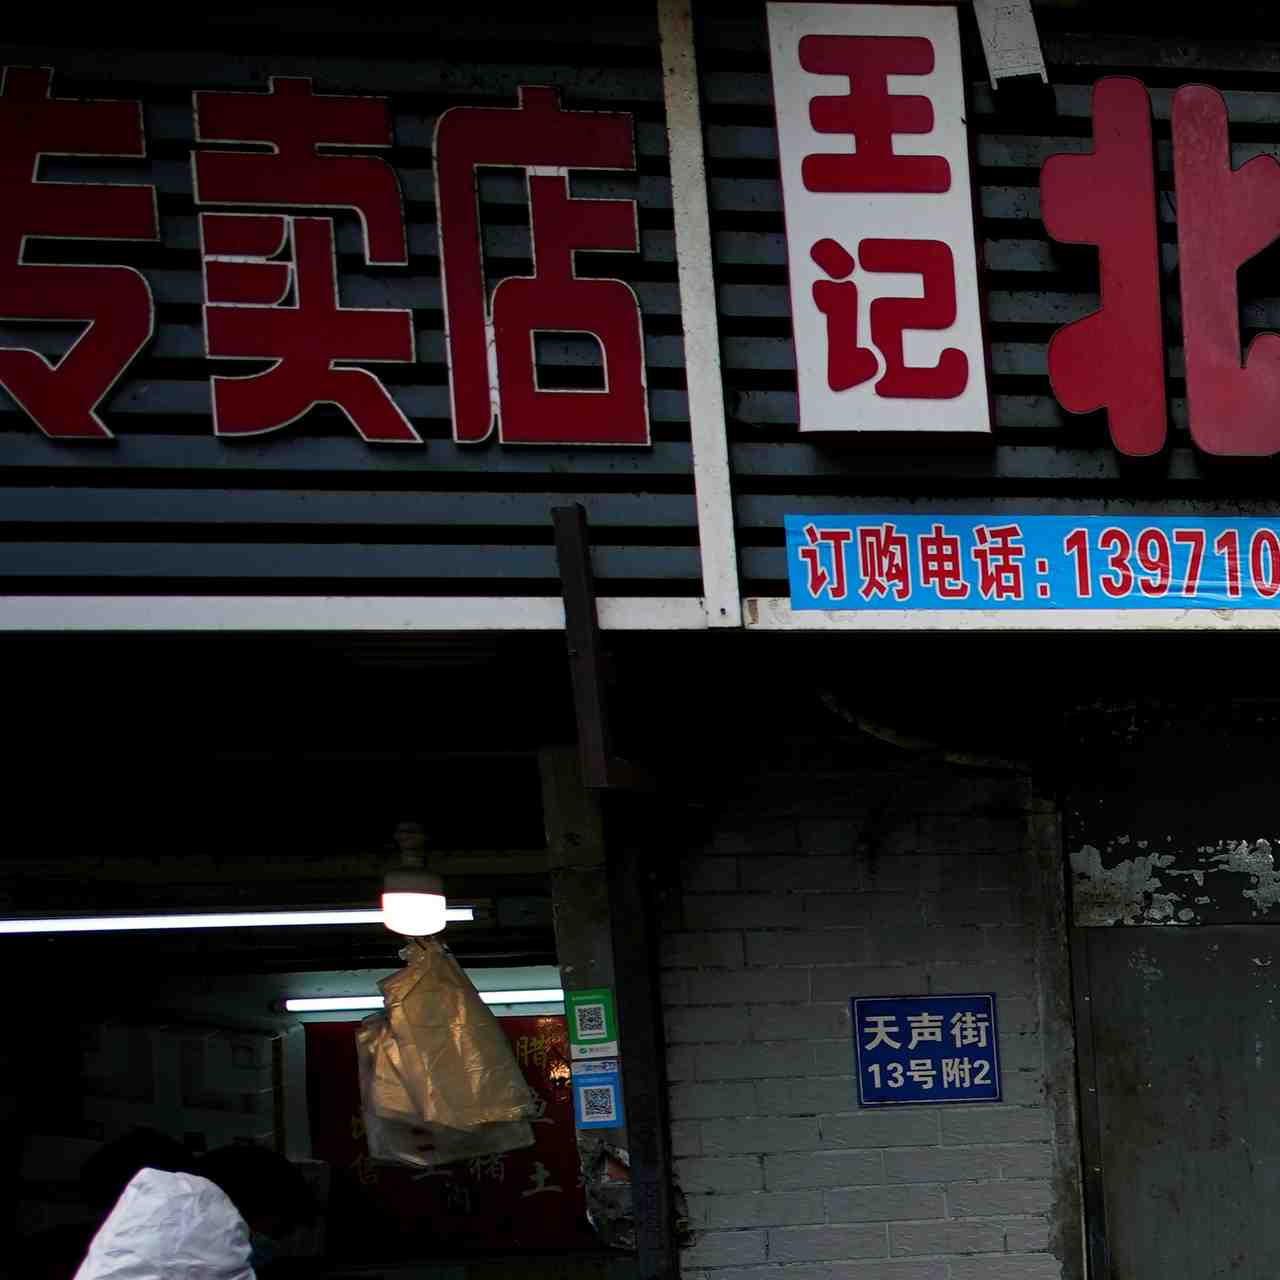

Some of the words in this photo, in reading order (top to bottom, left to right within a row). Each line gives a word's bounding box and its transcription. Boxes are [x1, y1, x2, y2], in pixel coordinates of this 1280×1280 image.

[0, 66, 651, 447] 专卖店
[798, 34, 969, 399] 王记
[863, 1012, 989, 1051] 天声街
[866, 1057, 991, 1090] 13号附2
